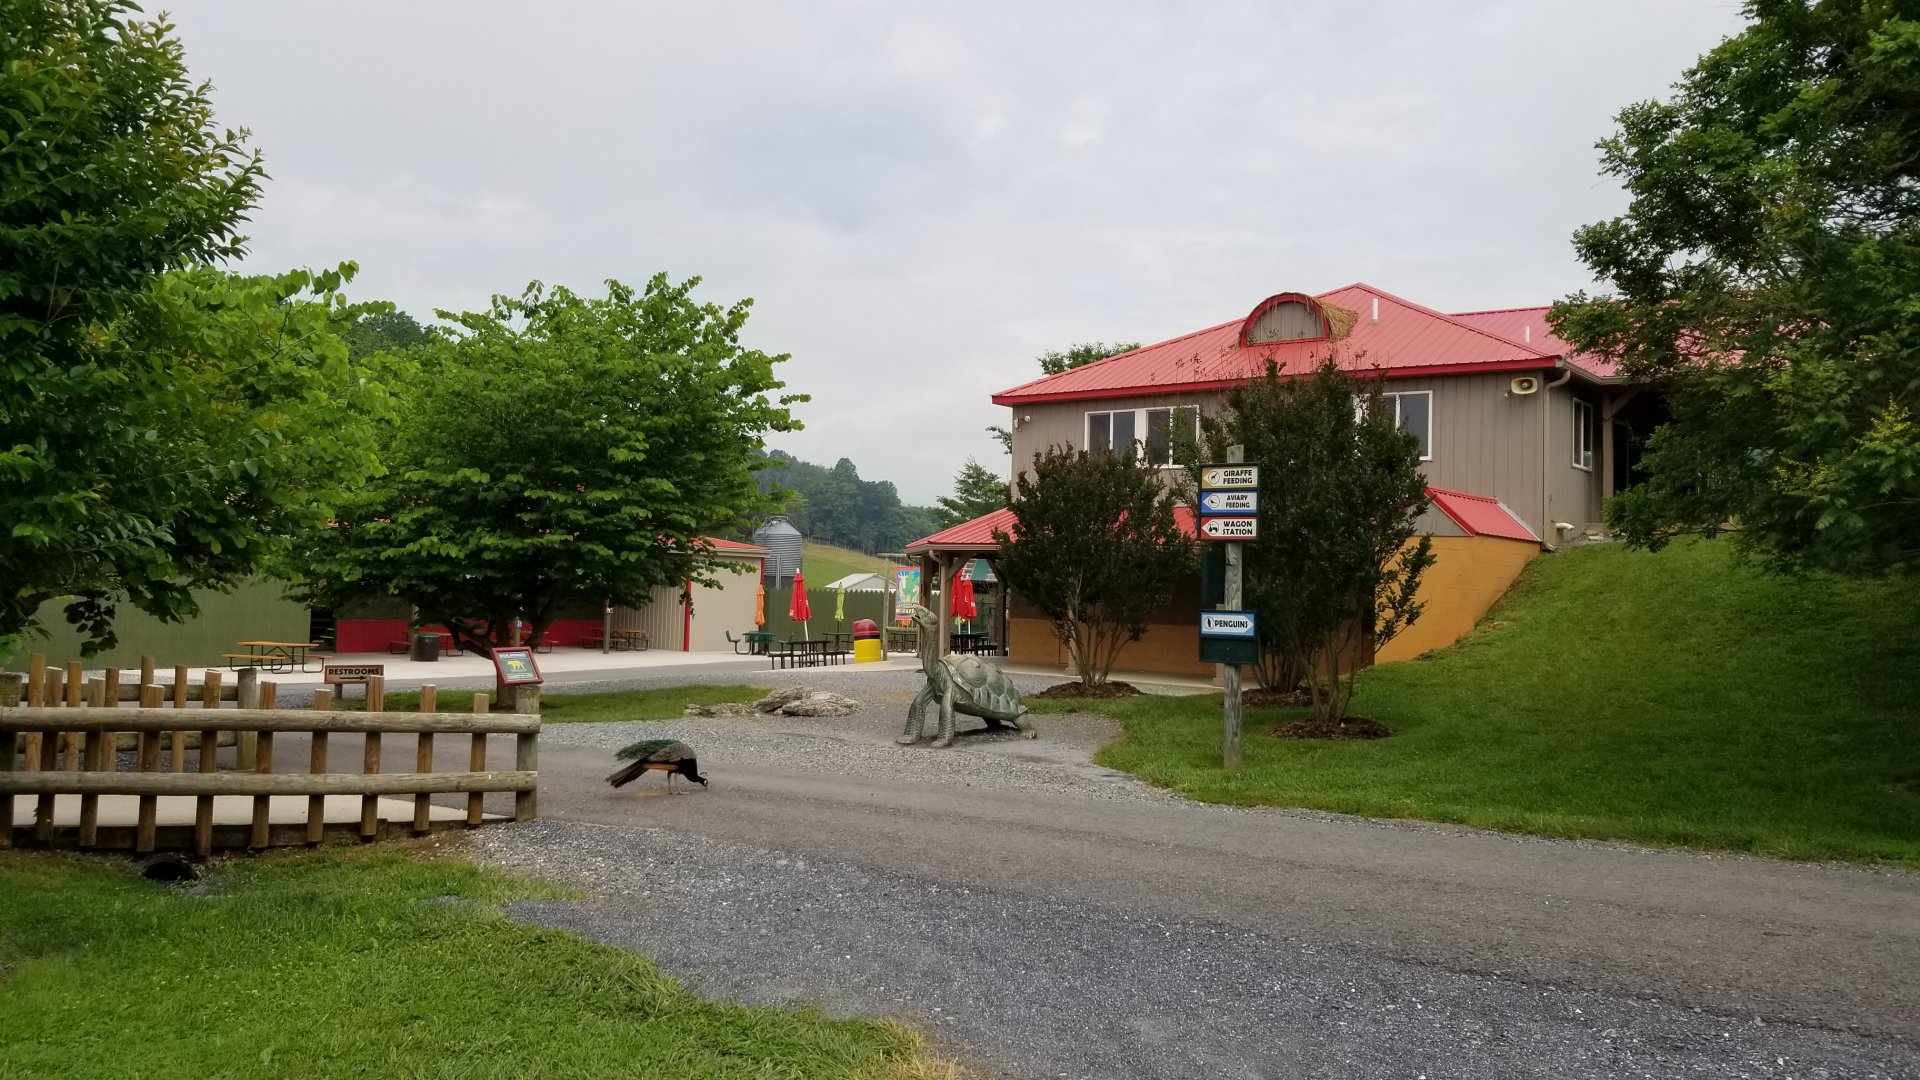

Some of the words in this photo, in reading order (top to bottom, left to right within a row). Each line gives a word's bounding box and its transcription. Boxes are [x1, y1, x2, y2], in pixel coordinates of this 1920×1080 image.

[1223, 469, 1253, 477] GIRAFFE
[1223, 520, 1253, 528] WAGON
[1214, 619, 1248, 628] PENGUINS
